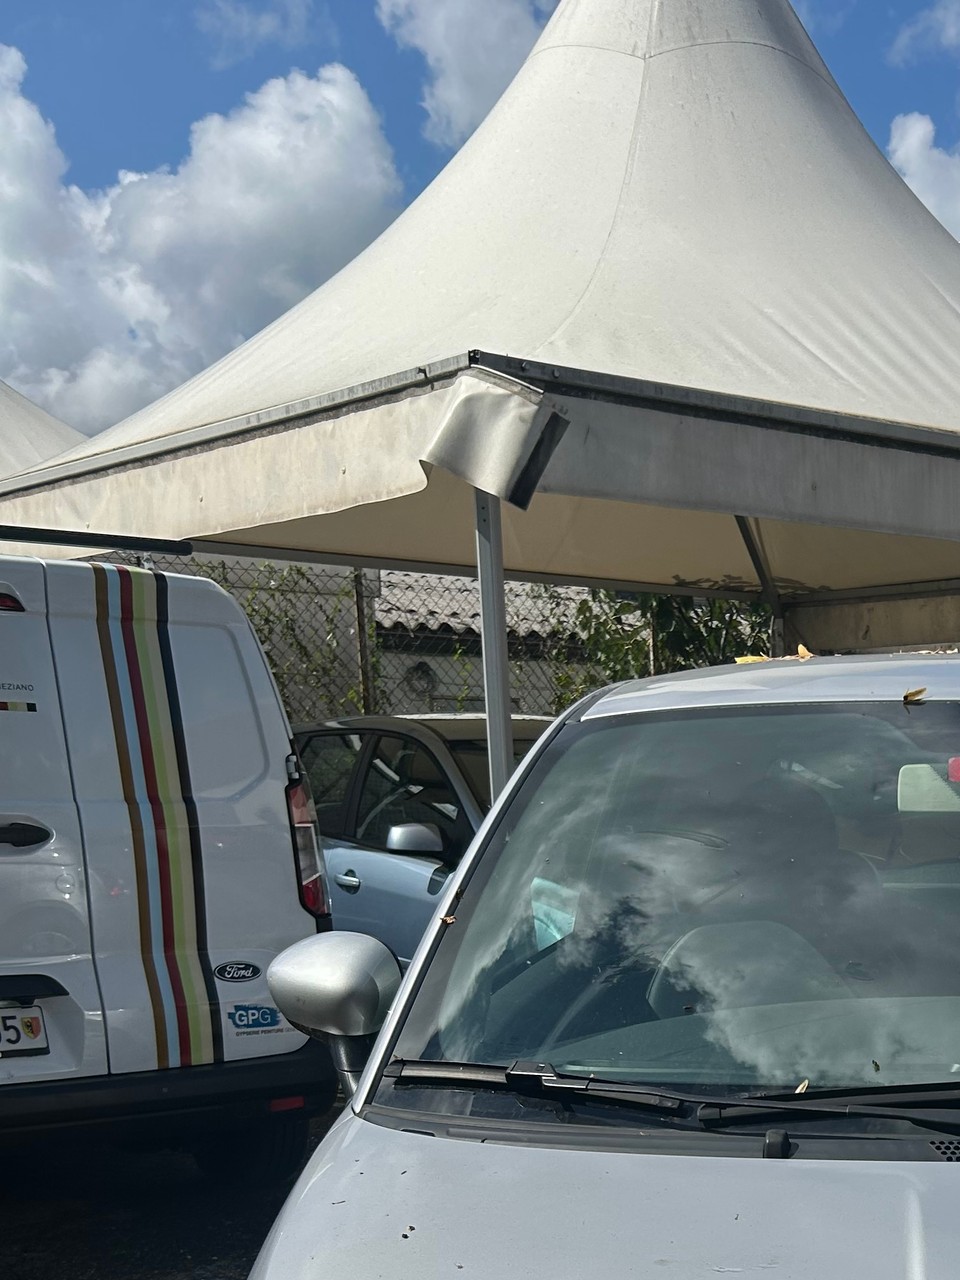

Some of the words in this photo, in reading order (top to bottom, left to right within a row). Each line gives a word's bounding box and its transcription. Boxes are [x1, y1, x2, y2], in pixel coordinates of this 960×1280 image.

[0, 683, 34, 691] EZIANO
[224, 964, 254, 978] Ford
[235, 1008, 271, 1026] GPG
